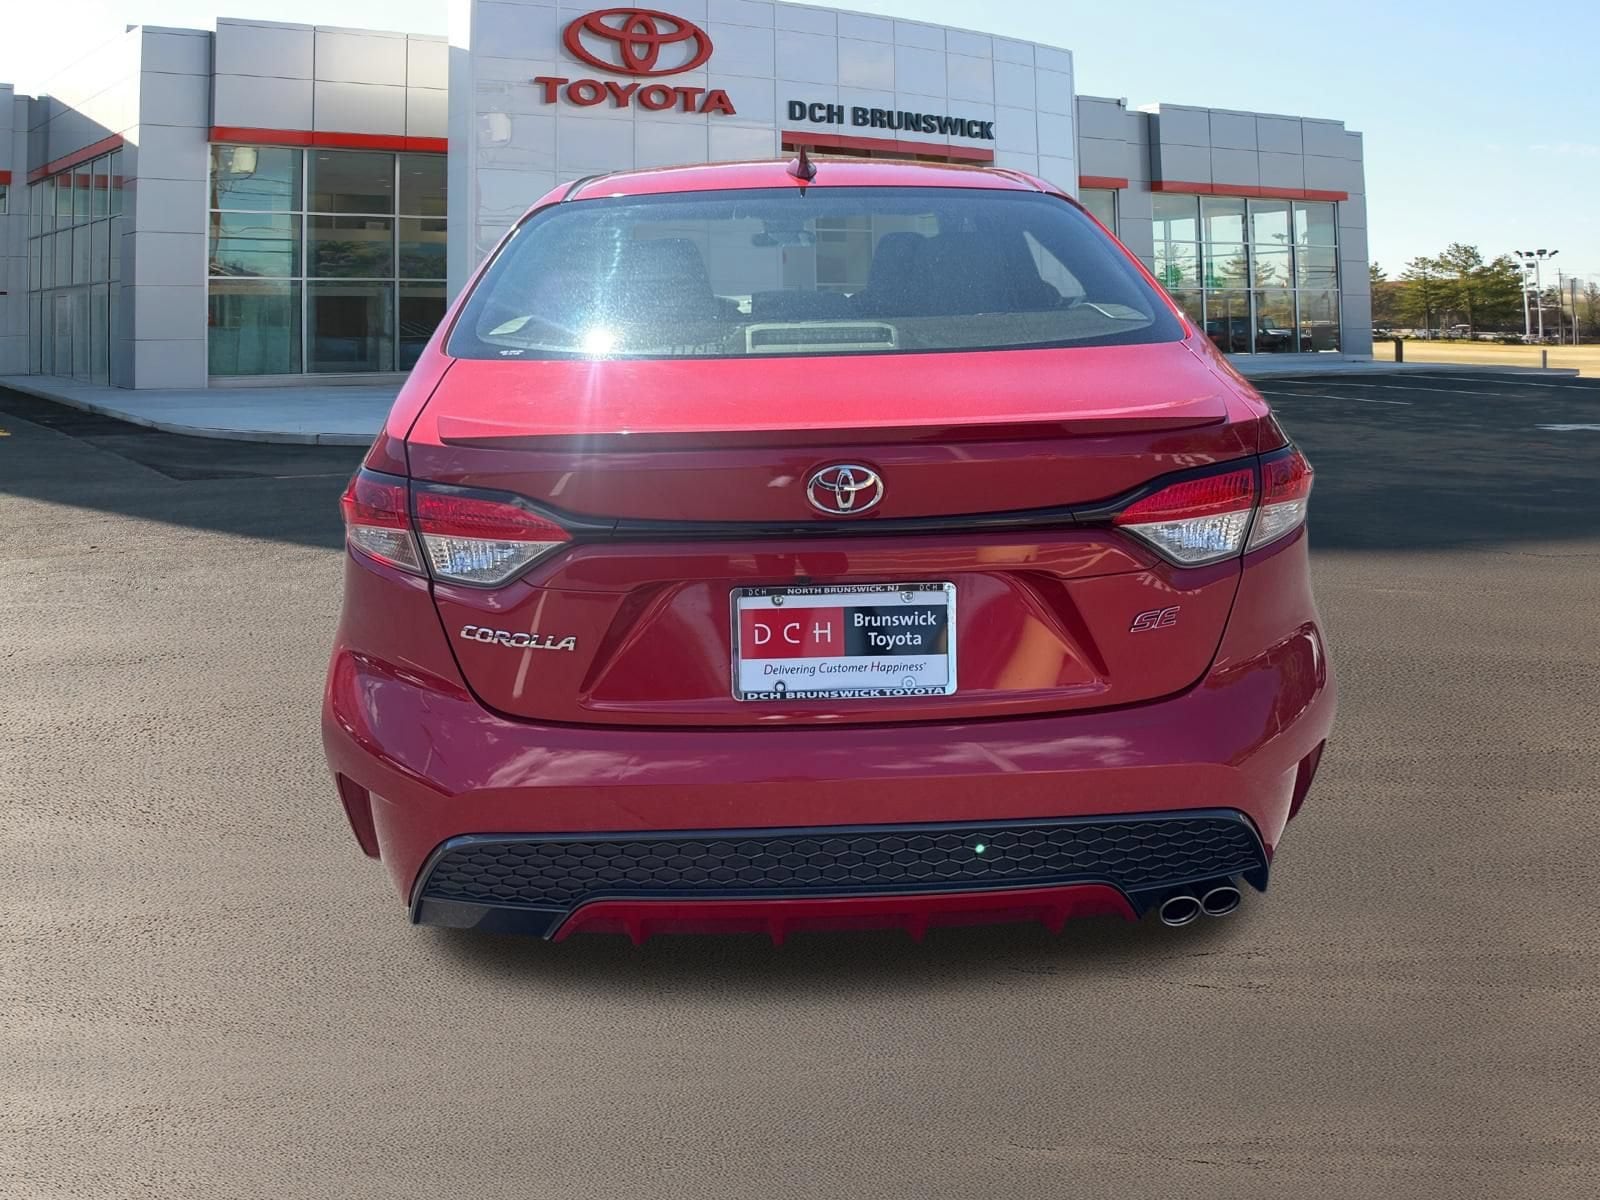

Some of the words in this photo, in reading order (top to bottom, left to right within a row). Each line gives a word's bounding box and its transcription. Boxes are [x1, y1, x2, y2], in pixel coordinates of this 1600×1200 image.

[535, 76, 736, 115] TOYOTA
[788, 100, 844, 125] DCH
[852, 106, 994, 140] BRUNSWICK
[787, 587, 822, 595] NORTH
[887, 584, 899, 592] NJ
[854, 611, 937, 628] Brunswick
[1129, 605, 1181, 633] SE
[460, 624, 577, 651] COROLLA
[868, 632, 923, 651] Toyota
[763, 663, 816, 677] Delivering
[818, 662, 868, 673] Customer
[747, 692, 781, 700] DCH
[785, 688, 881, 699] BRUNSWICK
[883, 686, 944, 697] TOYOTA
